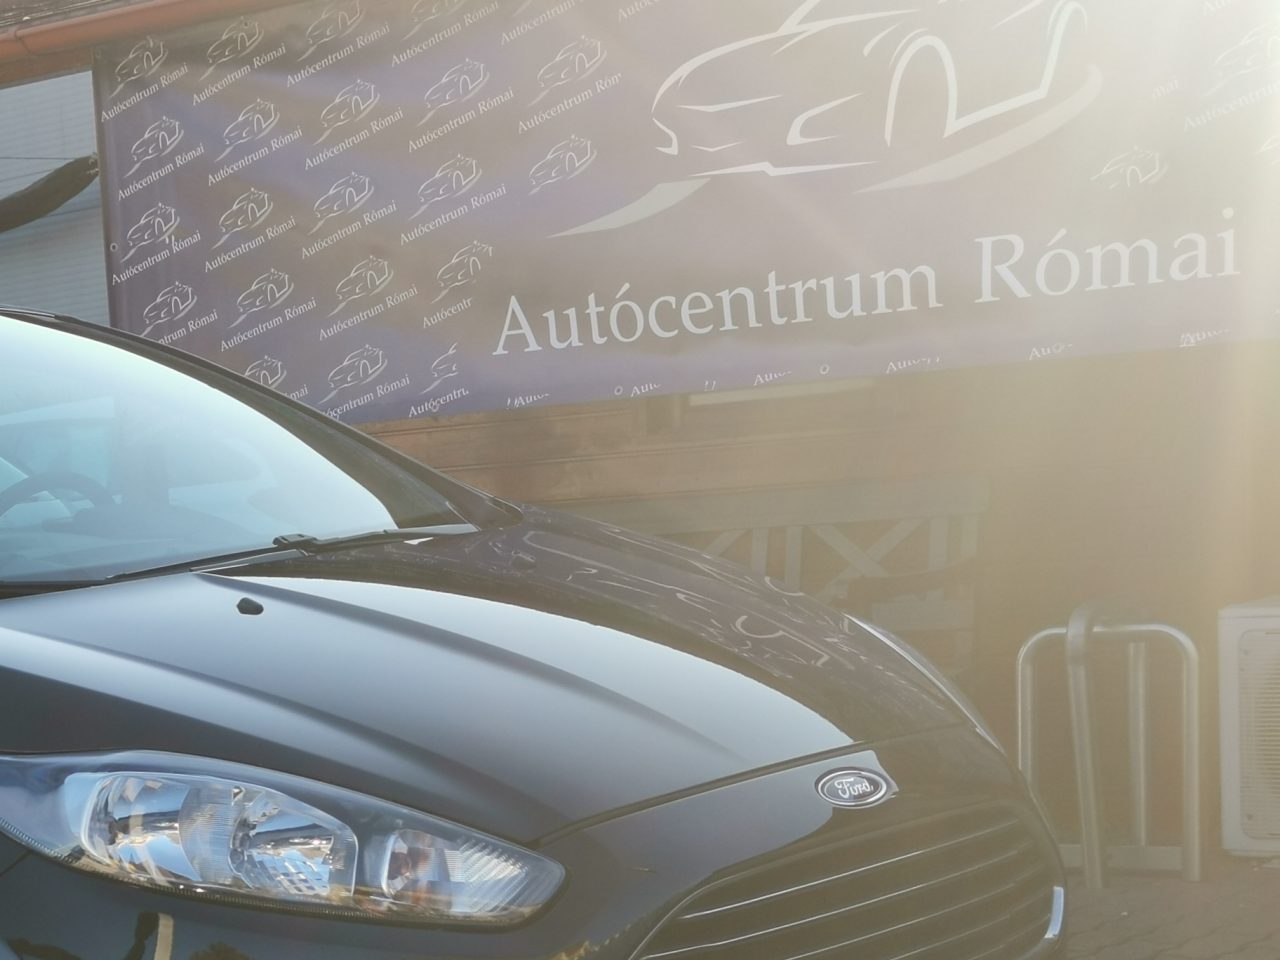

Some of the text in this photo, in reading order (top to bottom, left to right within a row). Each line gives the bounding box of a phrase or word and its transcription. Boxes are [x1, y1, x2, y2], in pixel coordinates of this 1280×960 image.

[286, 22, 391, 88] Autócentrum Római
[391, 22, 461, 67] Autócentrum
[101, 63, 189, 123] Autócentrum Római
[192, 43, 287, 106] Autócentrum Római
[305, 108, 404, 171] Autócentrum Római
[408, 87, 515, 153] Autócentrum Római
[518, 90, 593, 135] Autócentrum
[117, 143, 205, 201] Autócentrum Római
[208, 127, 303, 187] Autócentrum Római
[205, 215, 297, 273] Autócentrum Római
[301, 202, 398, 260] Autócentrum Római
[400, 184, 507, 246] Autócentrum Római
[111, 248, 170, 286] Autócentrum
[492, 208, 1241, 356] Autócentrum Római
[187, 309, 218, 333] Római
[220, 298, 317, 353] Autócentrum Római
[319, 284, 419, 341] Autócentrum Római
[376, 373, 411, 400] Római
[834, 776, 874, 799] Ford
